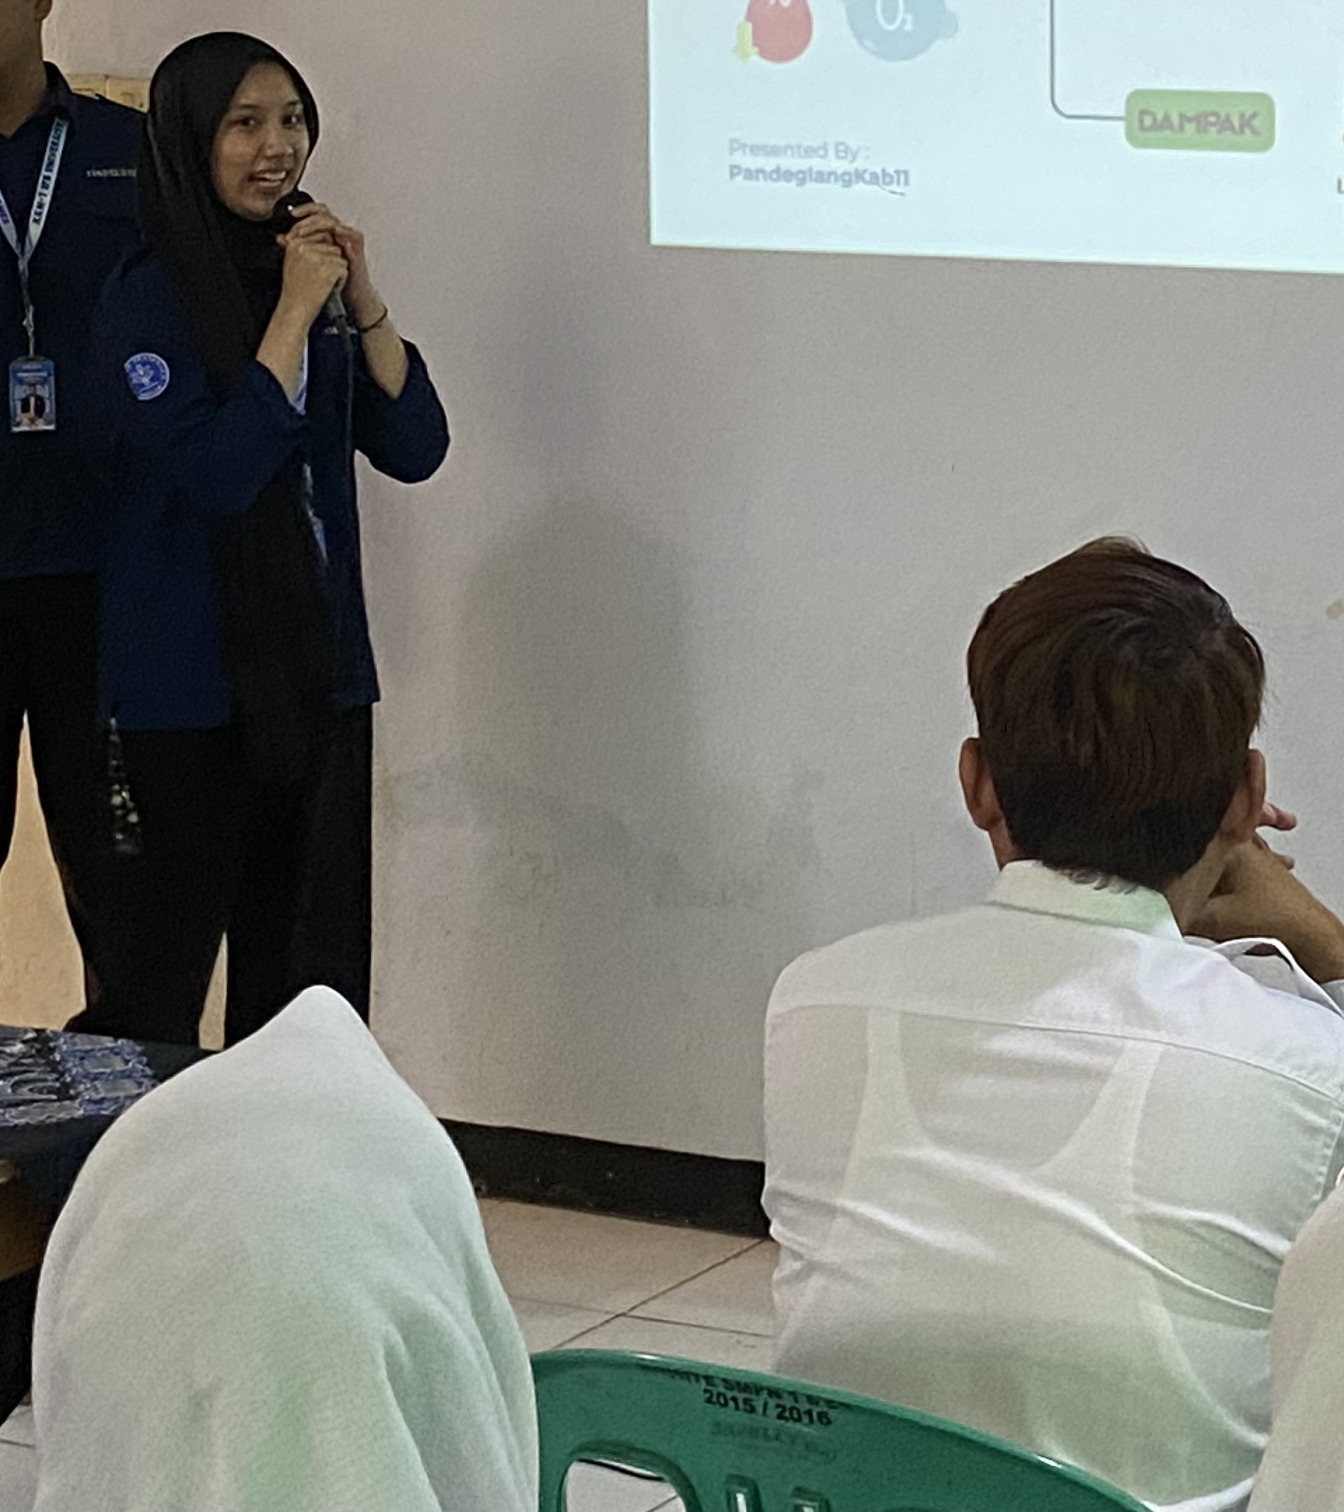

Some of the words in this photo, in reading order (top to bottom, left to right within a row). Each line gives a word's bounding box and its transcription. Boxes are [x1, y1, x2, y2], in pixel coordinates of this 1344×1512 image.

[1138, 109, 1262, 138] DAMPAK
[728, 137, 828, 160] Presented
[703, 1388, 757, 1415] 2015
[774, 1402, 833, 1427] 2016
